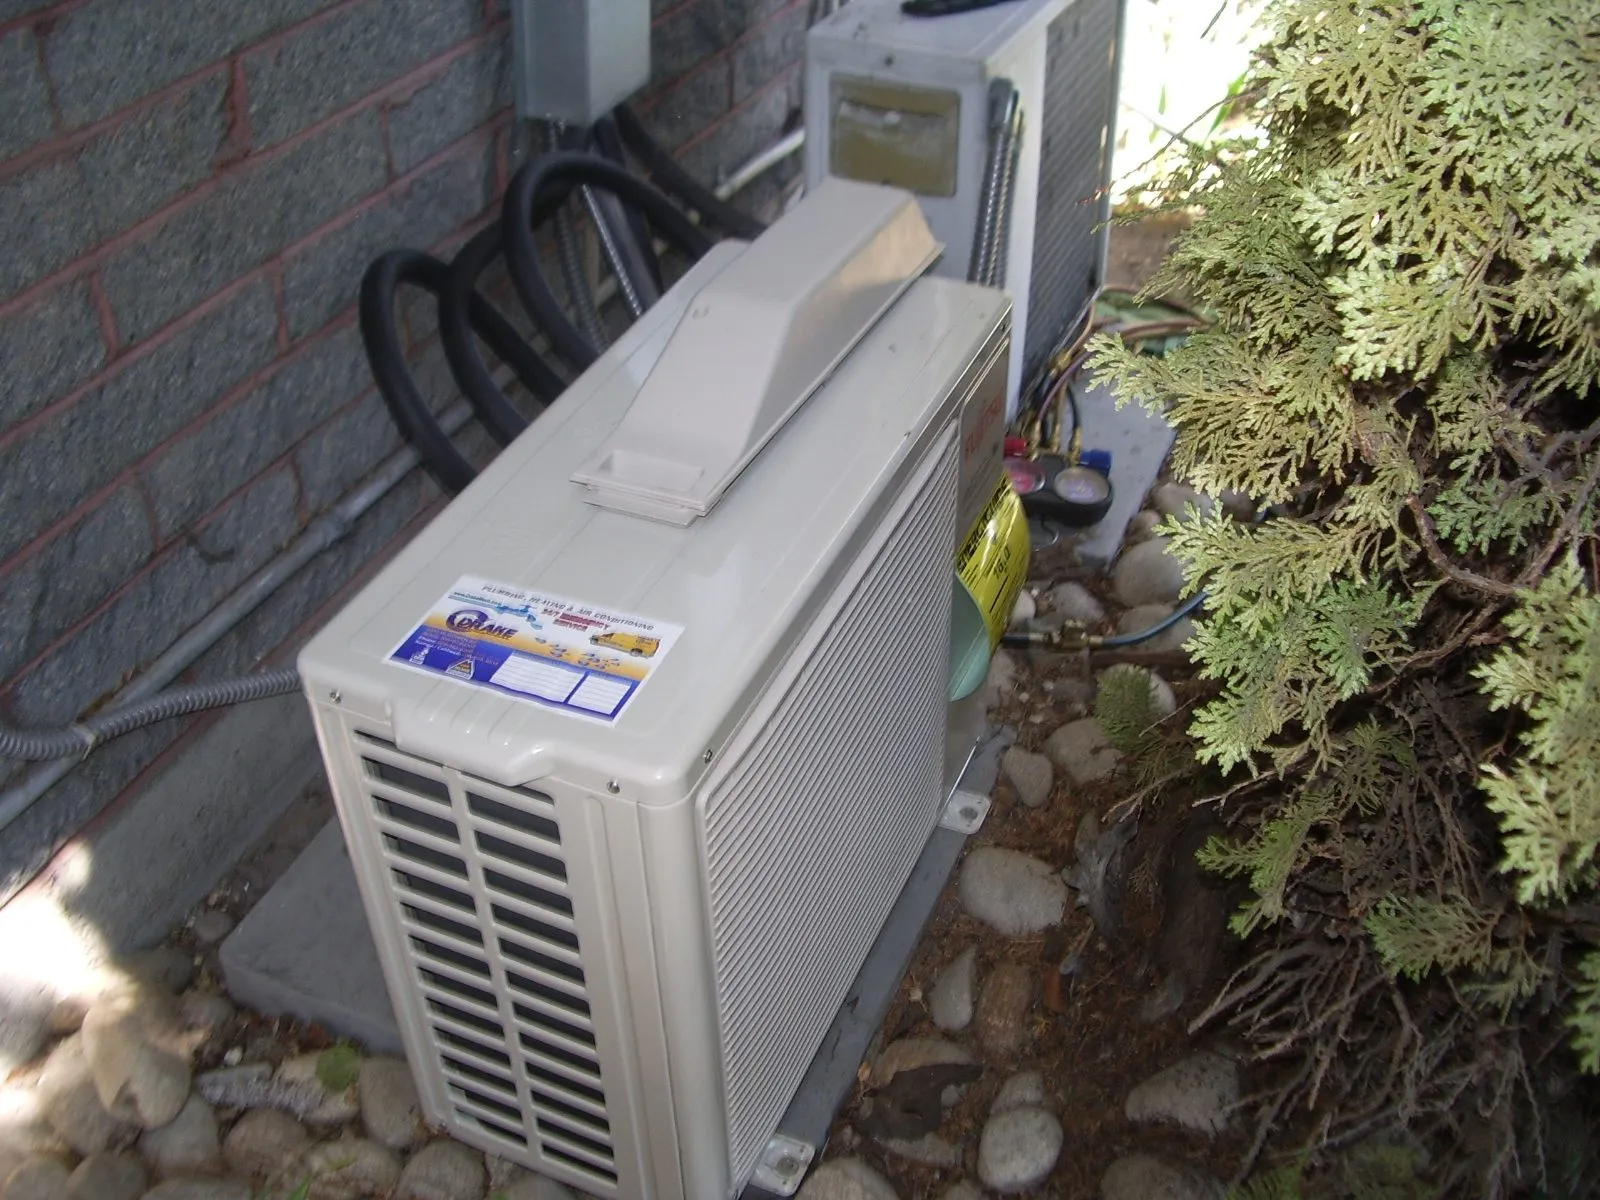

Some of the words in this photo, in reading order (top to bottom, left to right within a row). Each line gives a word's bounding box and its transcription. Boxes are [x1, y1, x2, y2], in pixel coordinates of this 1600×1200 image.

[456, 616, 519, 638] DRAKE
[577, 609, 592, 617] AIR
[594, 613, 654, 631] CONDITIONING
